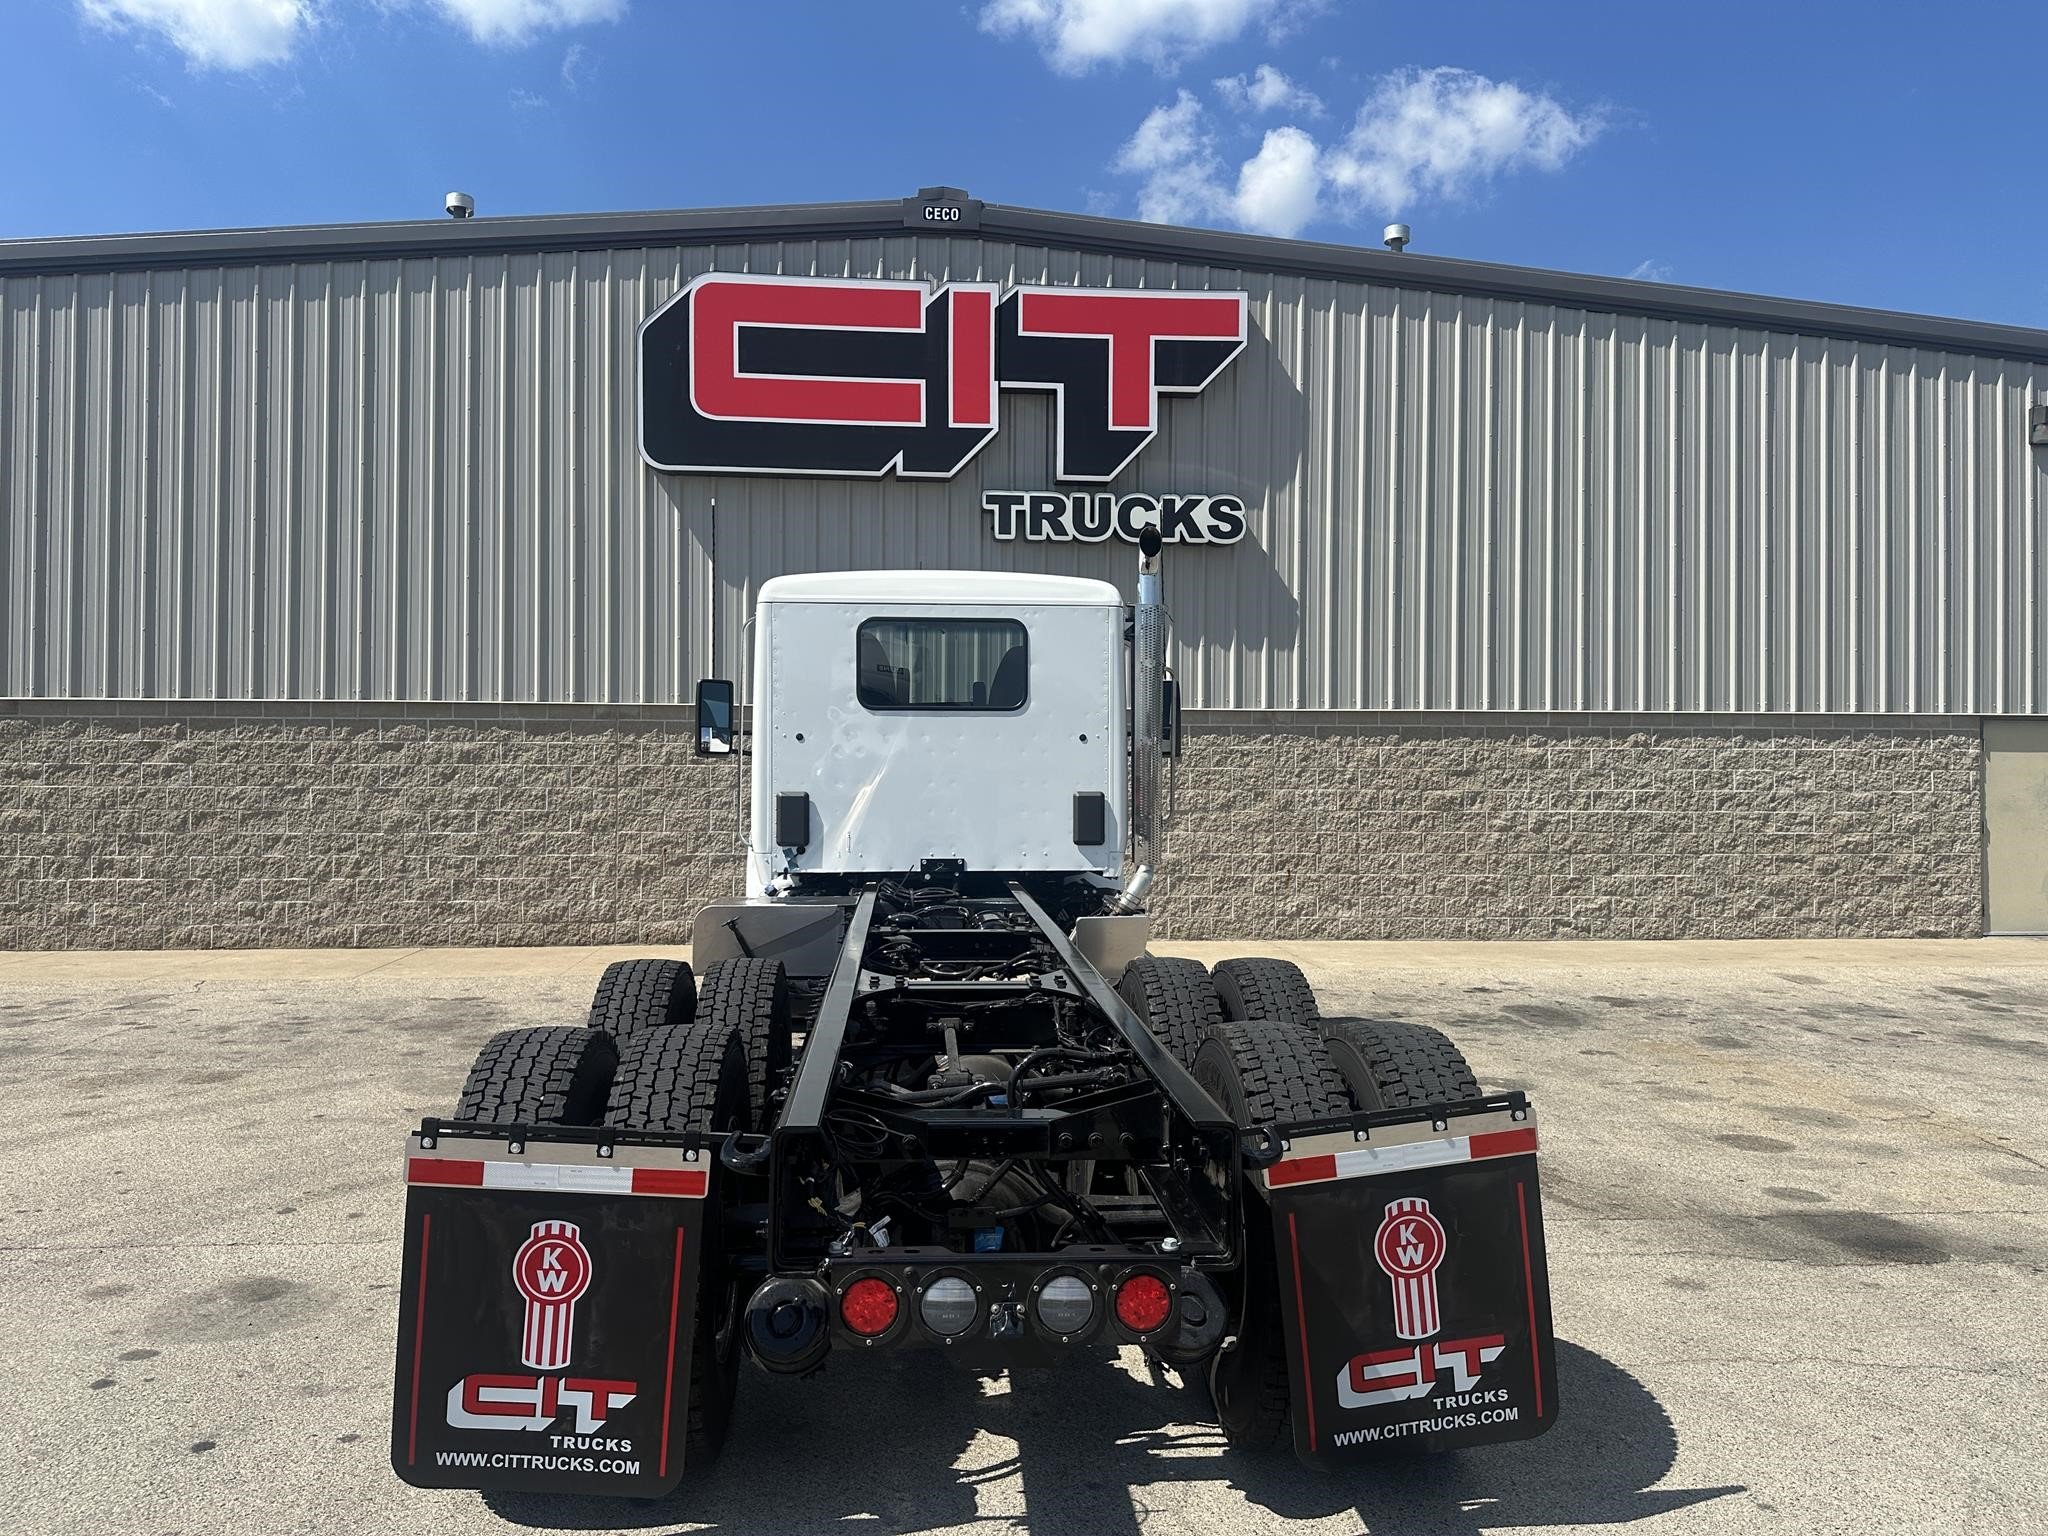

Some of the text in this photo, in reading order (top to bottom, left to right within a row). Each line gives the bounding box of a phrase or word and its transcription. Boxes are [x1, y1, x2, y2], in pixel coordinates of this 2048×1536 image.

[925, 206, 959, 221] CECO
[660, 276, 1247, 458] CIT
[984, 493, 1245, 541] TRUCKS
[1401, 1223, 1417, 1245] K
[543, 1247, 563, 1269] K
[1396, 1244, 1424, 1267] W
[537, 1271, 568, 1292] W
[1339, 1334, 1505, 1405] CIT
[449, 1374, 637, 1431] CIT
[1433, 1388, 1509, 1410] TRUCKS
[1334, 1407, 1518, 1446] WWW.CITTRUCKS.COM
[550, 1435, 632, 1452] TRUCKS
[436, 1452, 640, 1474] WWW.CITTRUCKS.COM
